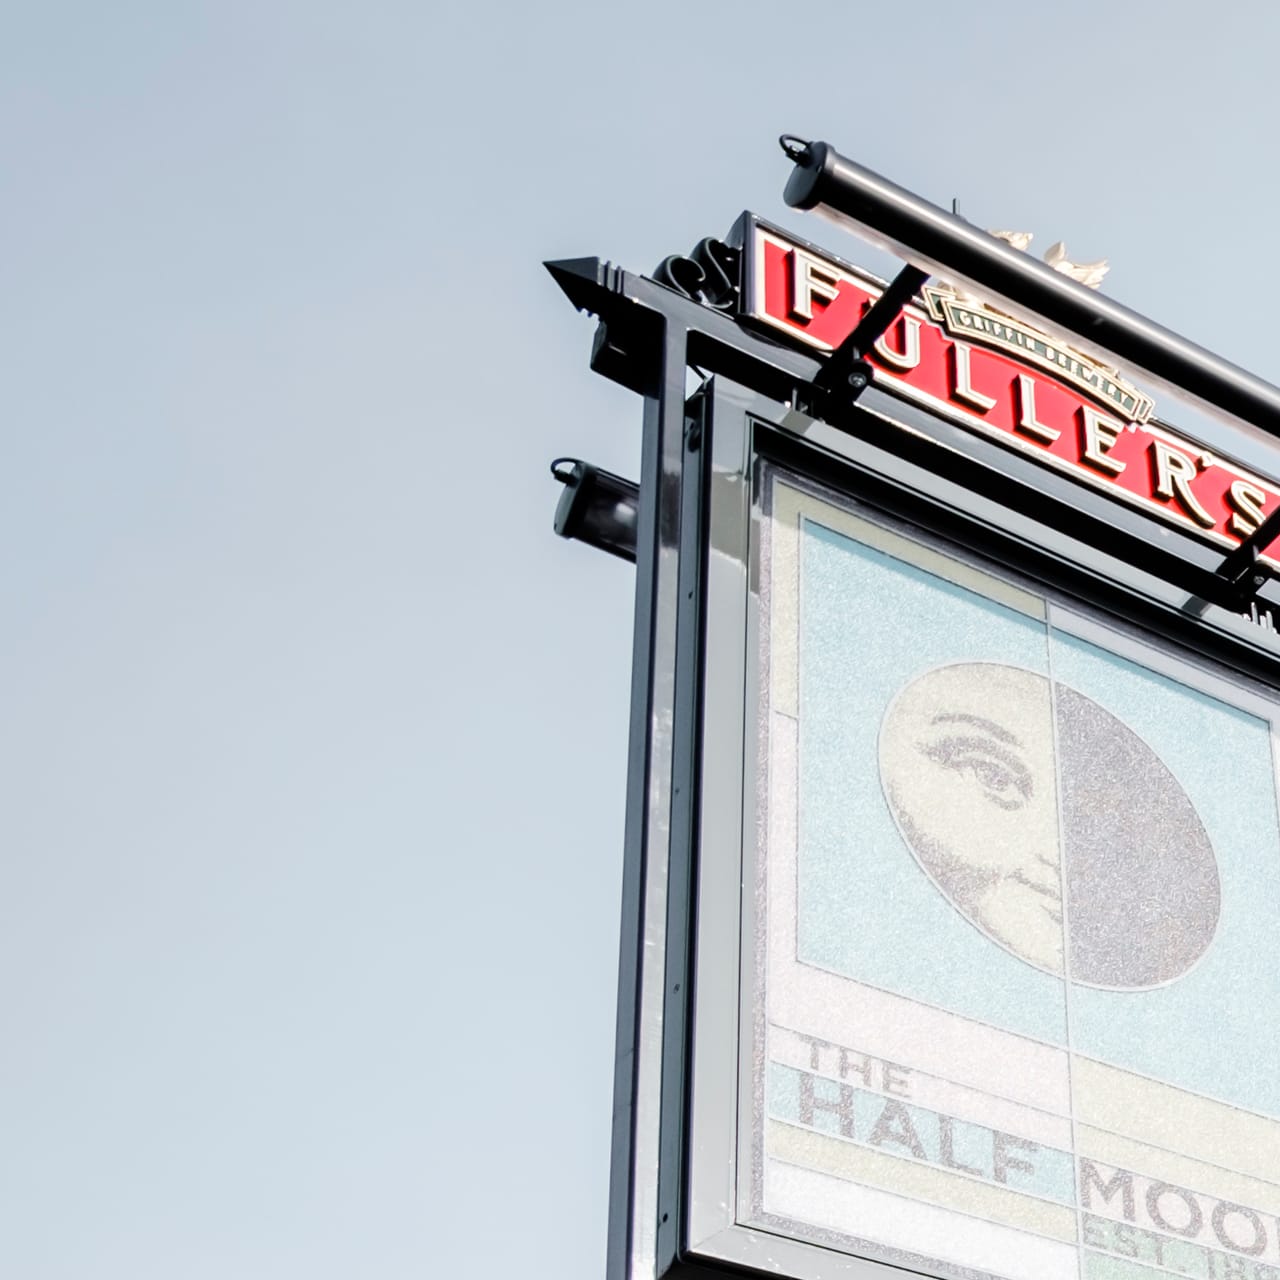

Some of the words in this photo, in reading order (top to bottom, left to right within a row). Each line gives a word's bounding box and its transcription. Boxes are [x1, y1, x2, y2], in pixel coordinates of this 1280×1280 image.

[793, 247, 1267, 536] FULLER'S
[959, 310, 1036, 352] GRIFFIN
[1045, 347, 1130, 406] BREWERY
[801, 1034, 913, 1100] THE
[799, 1070, 1039, 1184] HALF
[1083, 1213, 1187, 1274] EST.
